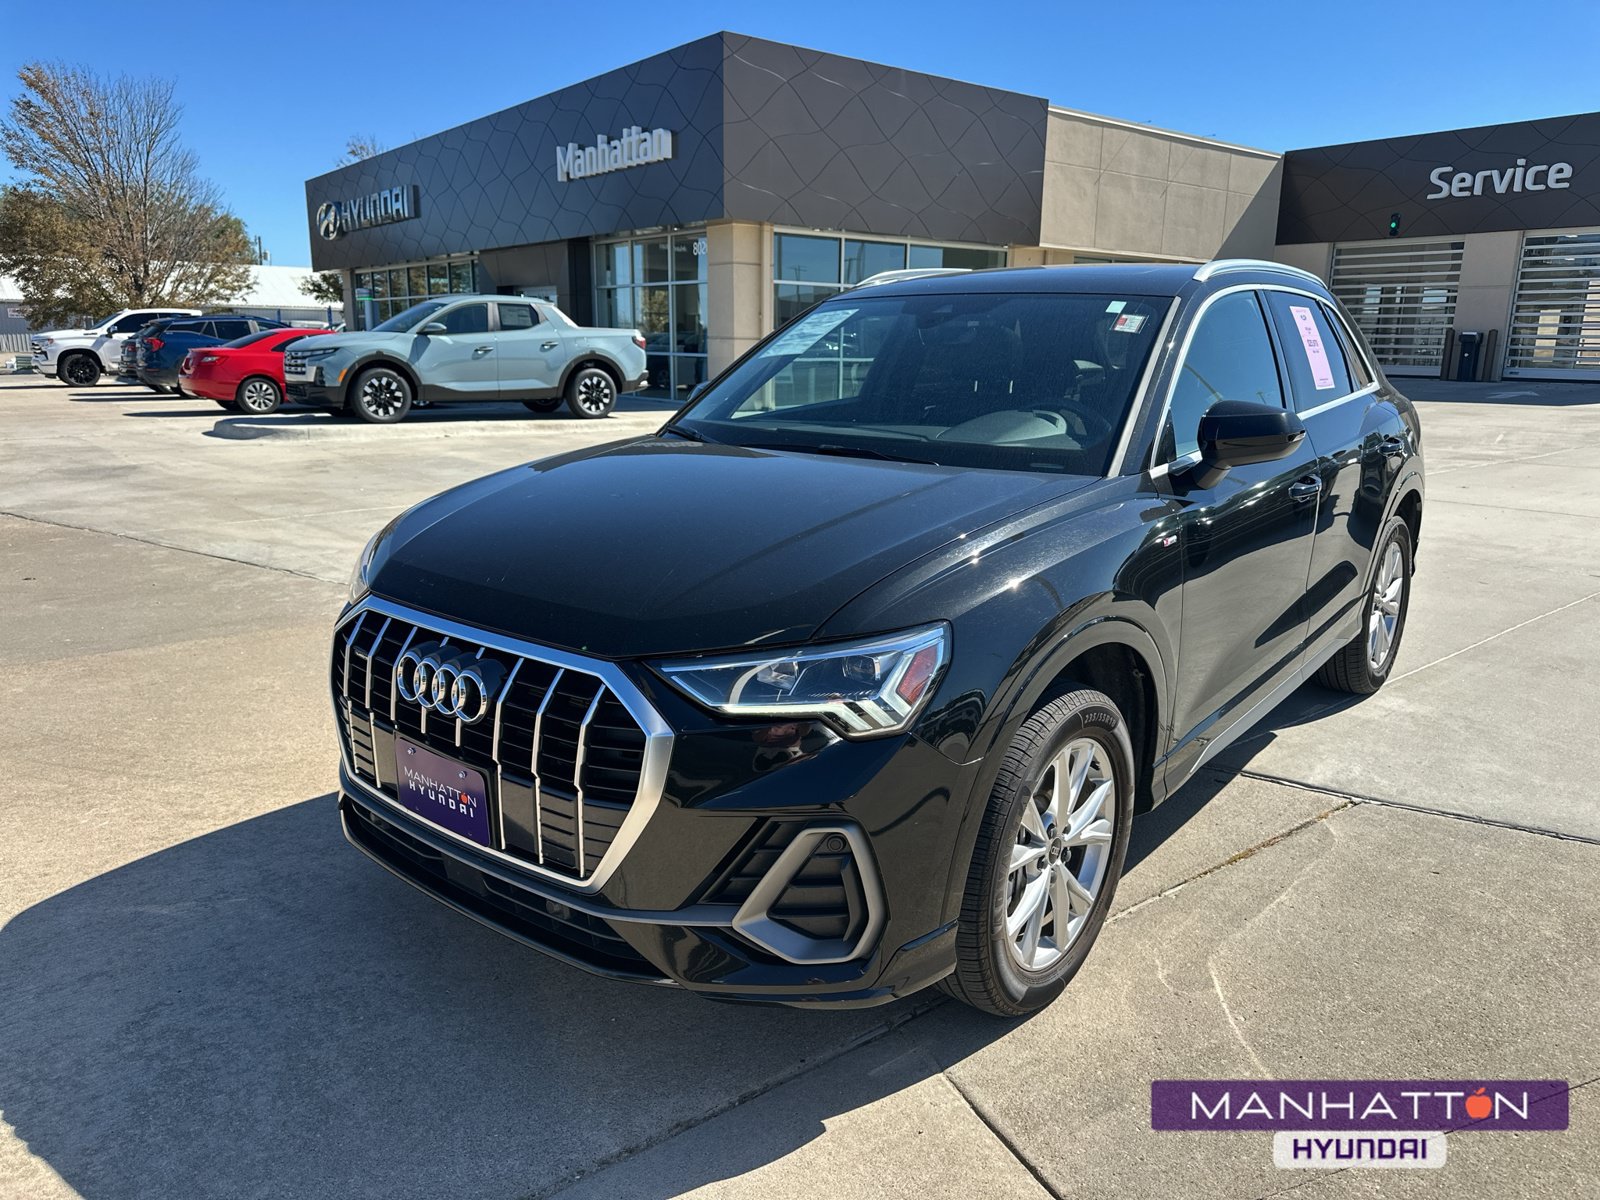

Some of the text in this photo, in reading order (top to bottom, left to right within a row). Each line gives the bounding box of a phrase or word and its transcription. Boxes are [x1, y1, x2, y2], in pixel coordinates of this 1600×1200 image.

[556, 126, 673, 182] Manhattan
[1427, 159, 1573, 199] Service
[341, 184, 415, 232] HYUNDAI
[404, 766, 477, 808] MANHATTN
[409, 780, 474, 817] HYUNDAI
